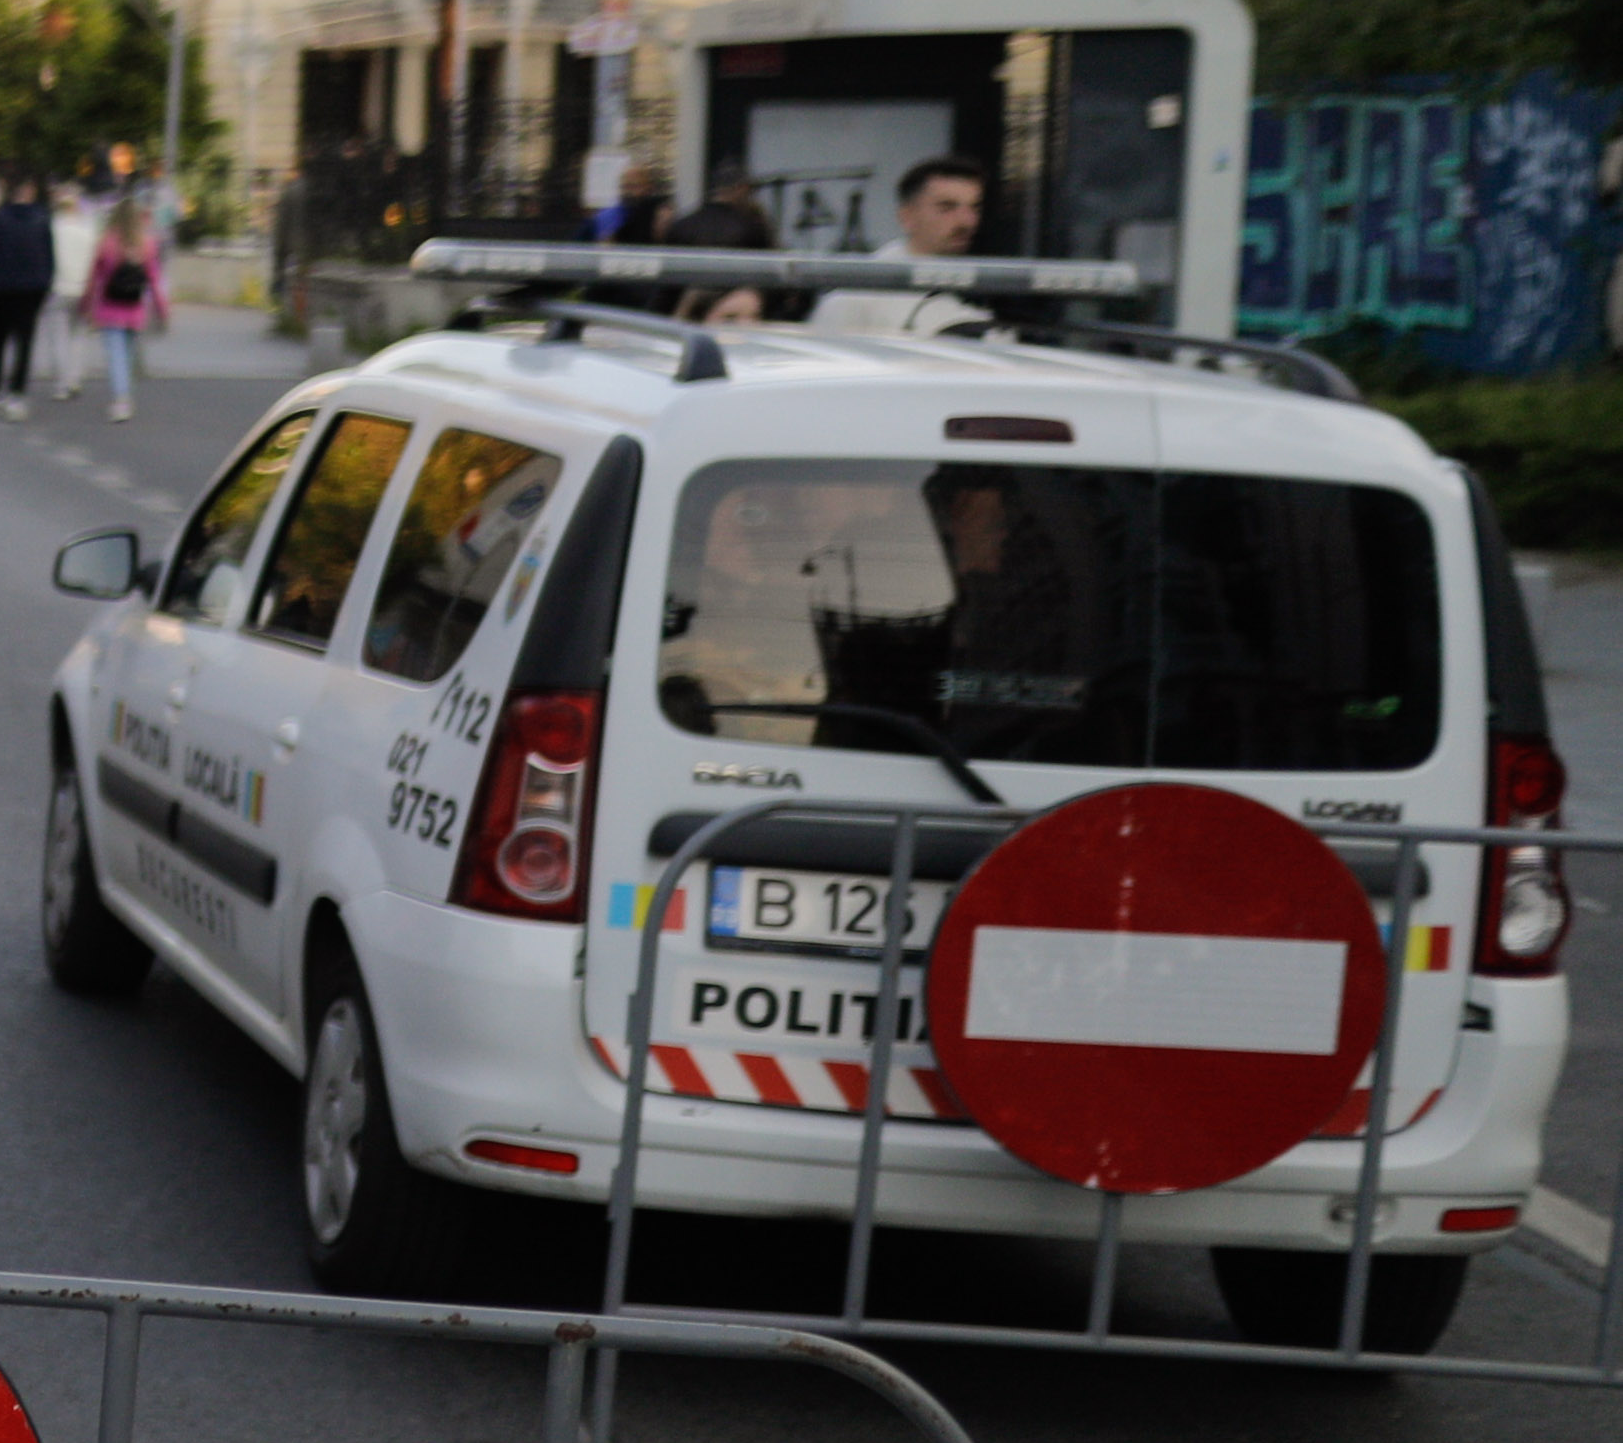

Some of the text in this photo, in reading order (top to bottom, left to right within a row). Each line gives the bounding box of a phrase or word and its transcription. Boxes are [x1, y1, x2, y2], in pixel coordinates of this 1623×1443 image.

[387, 730, 430, 777] 021
[692, 761, 803, 790] DACIA
[388, 781, 459, 850] 9752
[754, 878, 796, 929] B
